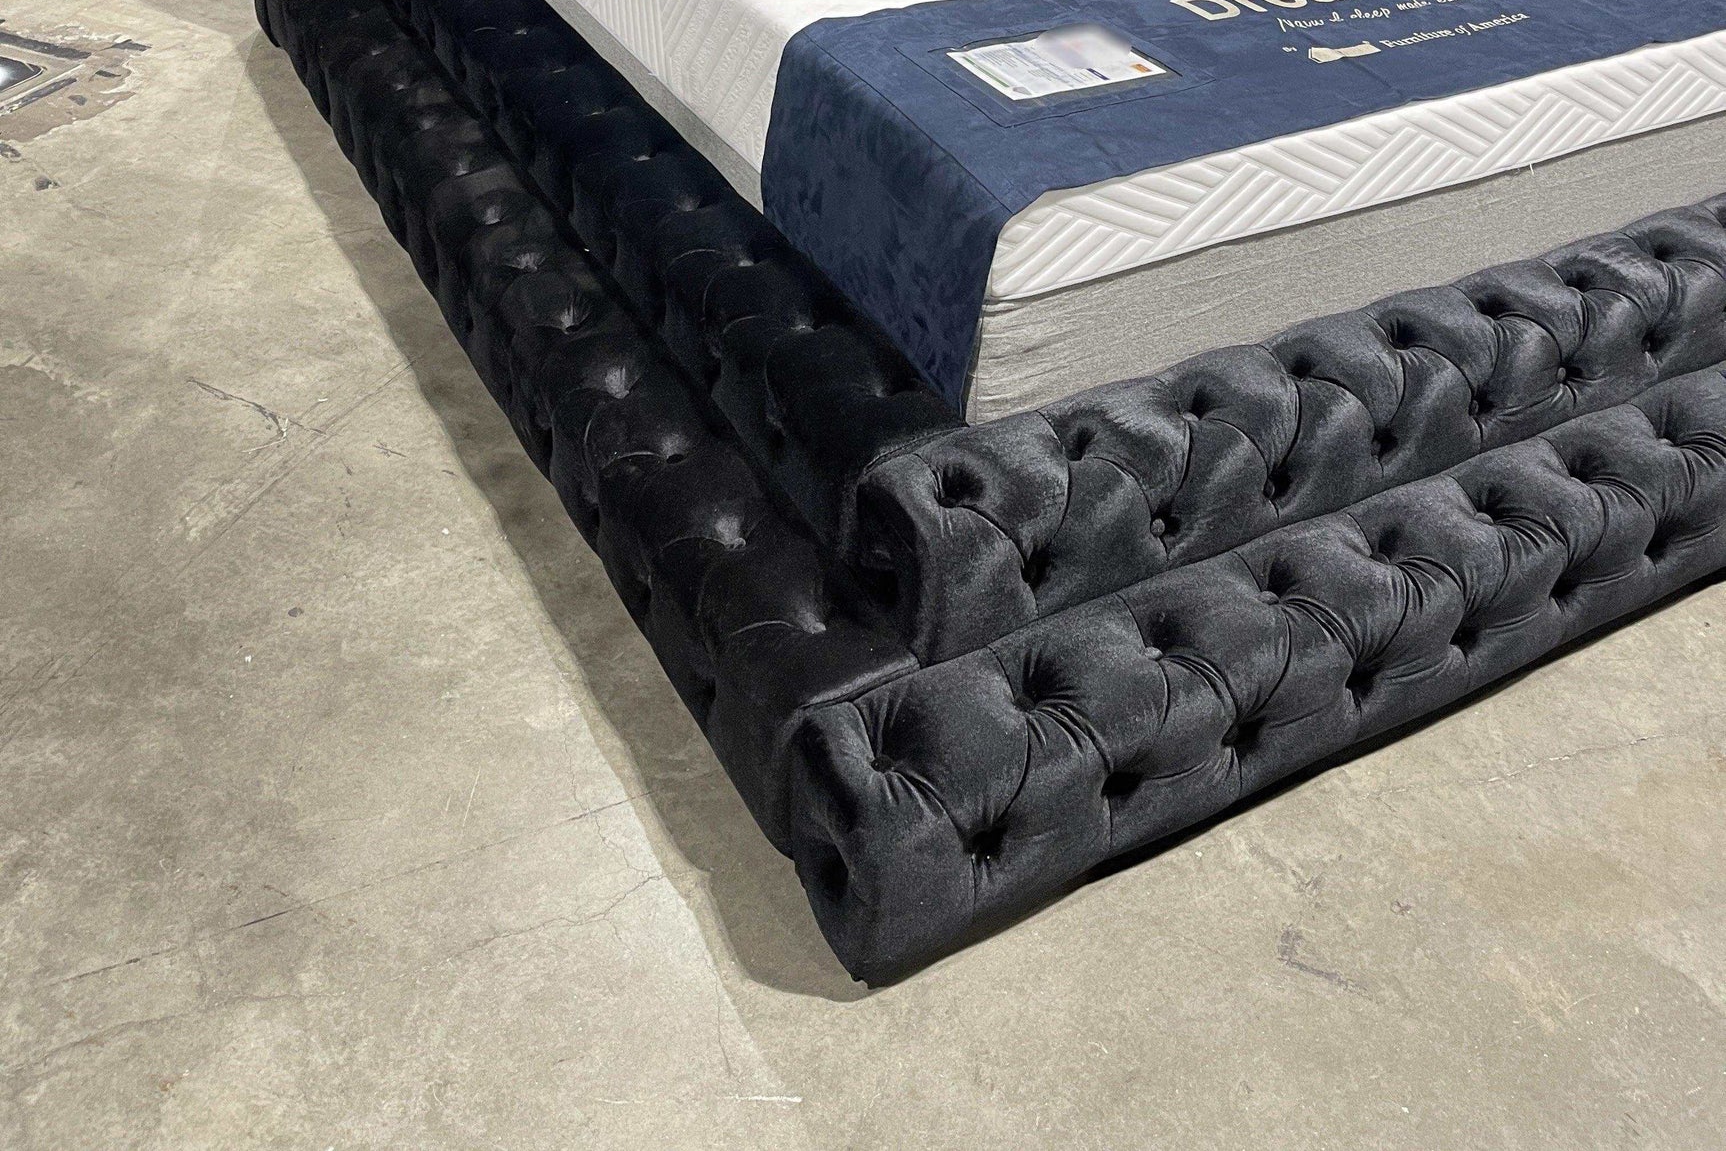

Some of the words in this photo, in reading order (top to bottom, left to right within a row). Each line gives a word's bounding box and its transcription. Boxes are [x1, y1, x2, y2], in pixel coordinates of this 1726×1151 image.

[1379, 32, 1455, 48] Furniture
[1454, 24, 1472, 36] of
[1467, 13, 1531, 32] America
